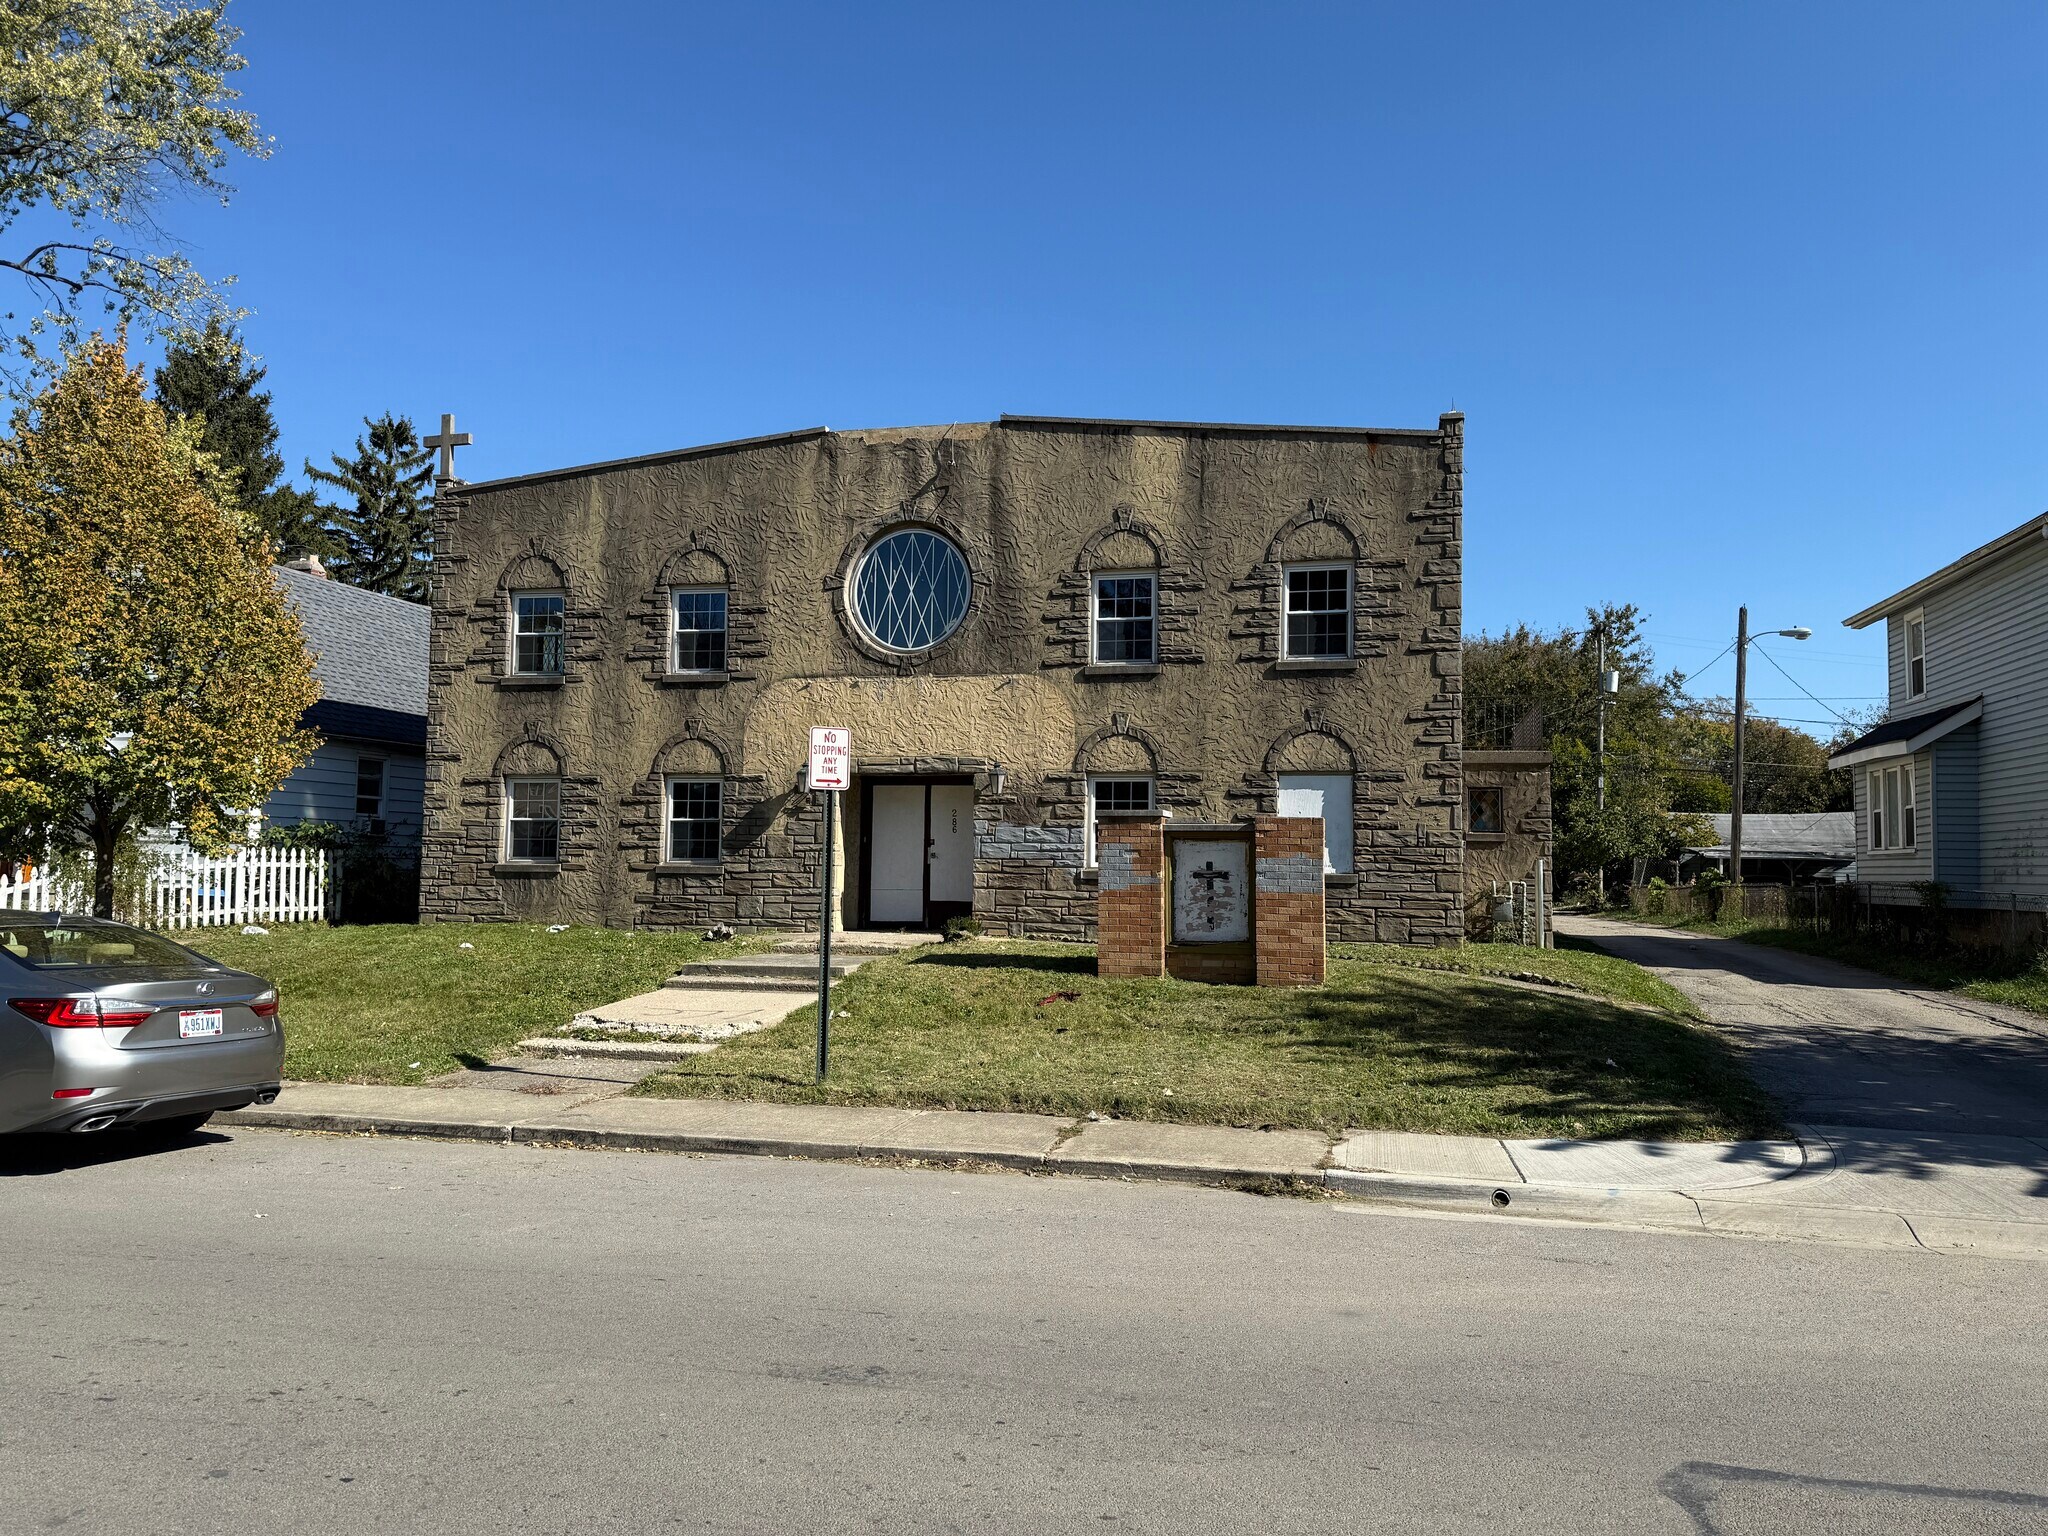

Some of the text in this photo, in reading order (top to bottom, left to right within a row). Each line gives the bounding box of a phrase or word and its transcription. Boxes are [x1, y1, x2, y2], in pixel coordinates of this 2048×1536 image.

[824, 733, 837, 743] NO
[813, 744, 847, 756] STOPPING
[823, 757, 837, 765] ANY
[821, 766, 838, 774] TIME
